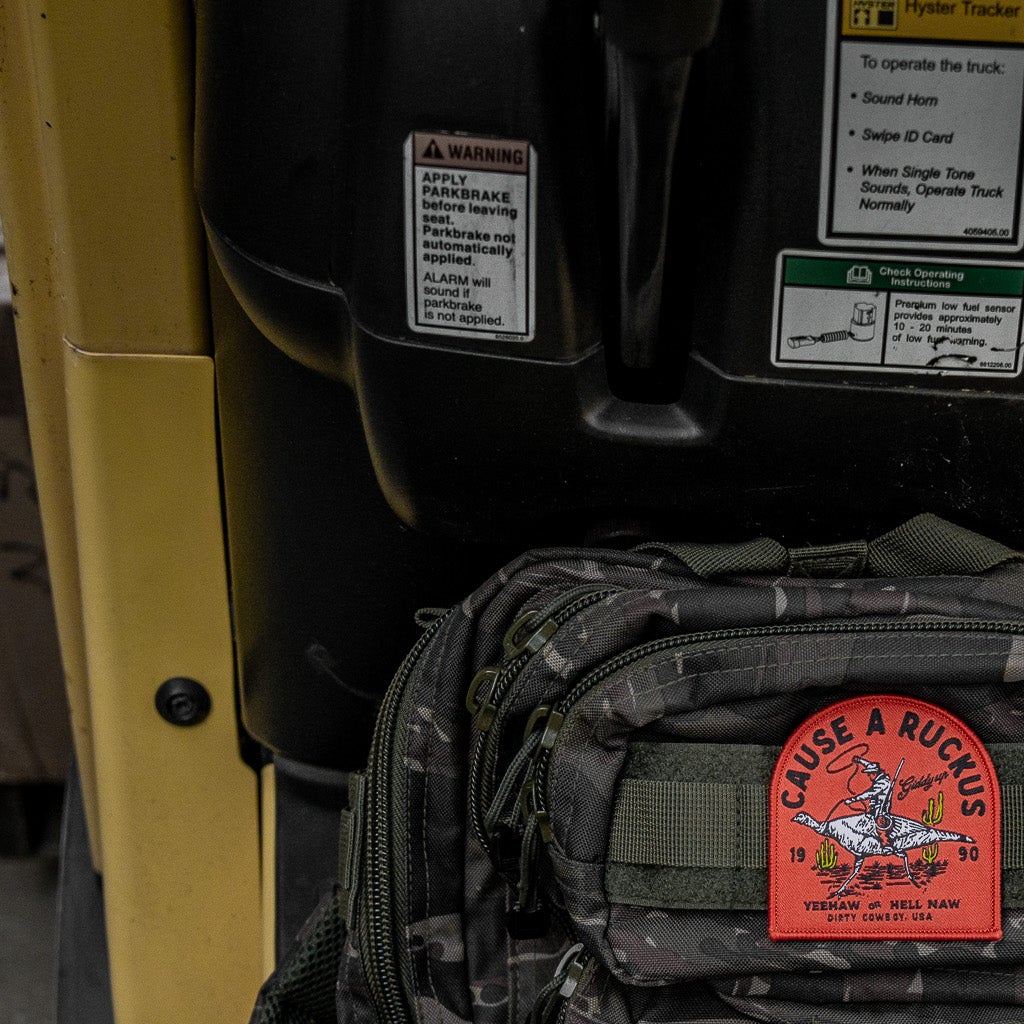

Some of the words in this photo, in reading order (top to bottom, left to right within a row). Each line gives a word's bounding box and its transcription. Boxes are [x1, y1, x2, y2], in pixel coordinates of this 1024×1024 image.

[905, 0, 956, 16] Hyster
[963, 1, 1020, 18] Tracker
[861, 55, 877, 69] To
[881, 58, 936, 73] operate
[940, 59, 962, 73] the
[967, 59, 1006, 75] truck:
[862, 91, 903, 106] Sound
[906, 94, 938, 107] Horn
[862, 128, 900, 143] Swipe
[904, 130, 918, 143] ID
[922, 131, 954, 145] Card
[448, 144, 523, 165] WARNING
[422, 172, 467, 187] APPLY
[862, 165, 898, 178] When
[902, 165, 941, 182] Single
[946, 168, 975, 181] Tone
[422, 186, 510, 203] PARKBRAKE
[860, 181, 911, 196] Sounds,
[915, 184, 966, 199] Operate
[970, 185, 1004, 198] Truck
[422, 199, 465, 213] before
[469, 201, 518, 220] leaving
[859, 199, 915, 214] Normally
[423, 214, 454, 226] seat.
[423, 226, 490, 242] Parkbrake
[494, 232, 516, 244] not
[423, 239, 513, 258] automatically
[423, 252, 475, 266] applied.
[423, 272, 469, 286] ALARM
[472, 276, 491, 288] will
[879, 266, 911, 278] Check
[913, 268, 964, 281] Operating
[424, 285, 459, 298] sound
[463, 287, 470, 298] if
[891, 278, 951, 289] Instructions
[424, 299, 482, 312] parkbrake
[895, 299, 937, 311] Premium
[942, 301, 958, 311] low
[963, 302, 980, 312] fuel
[984, 304, 1016, 314] sensor
[424, 311, 434, 320] is
[437, 312, 455, 322] not
[459, 313, 505, 327] applied.
[893, 311, 933, 322] provides
[938, 313, 1002, 326] approximately
[893, 322, 905, 331] 10
[919, 323, 932, 332] 20
[936, 324, 972, 335] minutes
[892, 334, 902, 343] of
[906, 334, 922, 344] low
[780, 715, 854, 809] CAUSE
[865, 707, 886, 736] A
[898, 710, 986, 817] RUCKUS
[897, 772, 934, 801] Giddy
[790, 847, 806, 863] 19
[959, 846, 979, 862] 90
[803, 901, 861, 911] YEEHAW
[890, 899, 922, 910] HELL
[928, 899, 960, 910] NAW
[827, 913, 856, 923] DIRTY
[912, 912, 933, 921] USA
